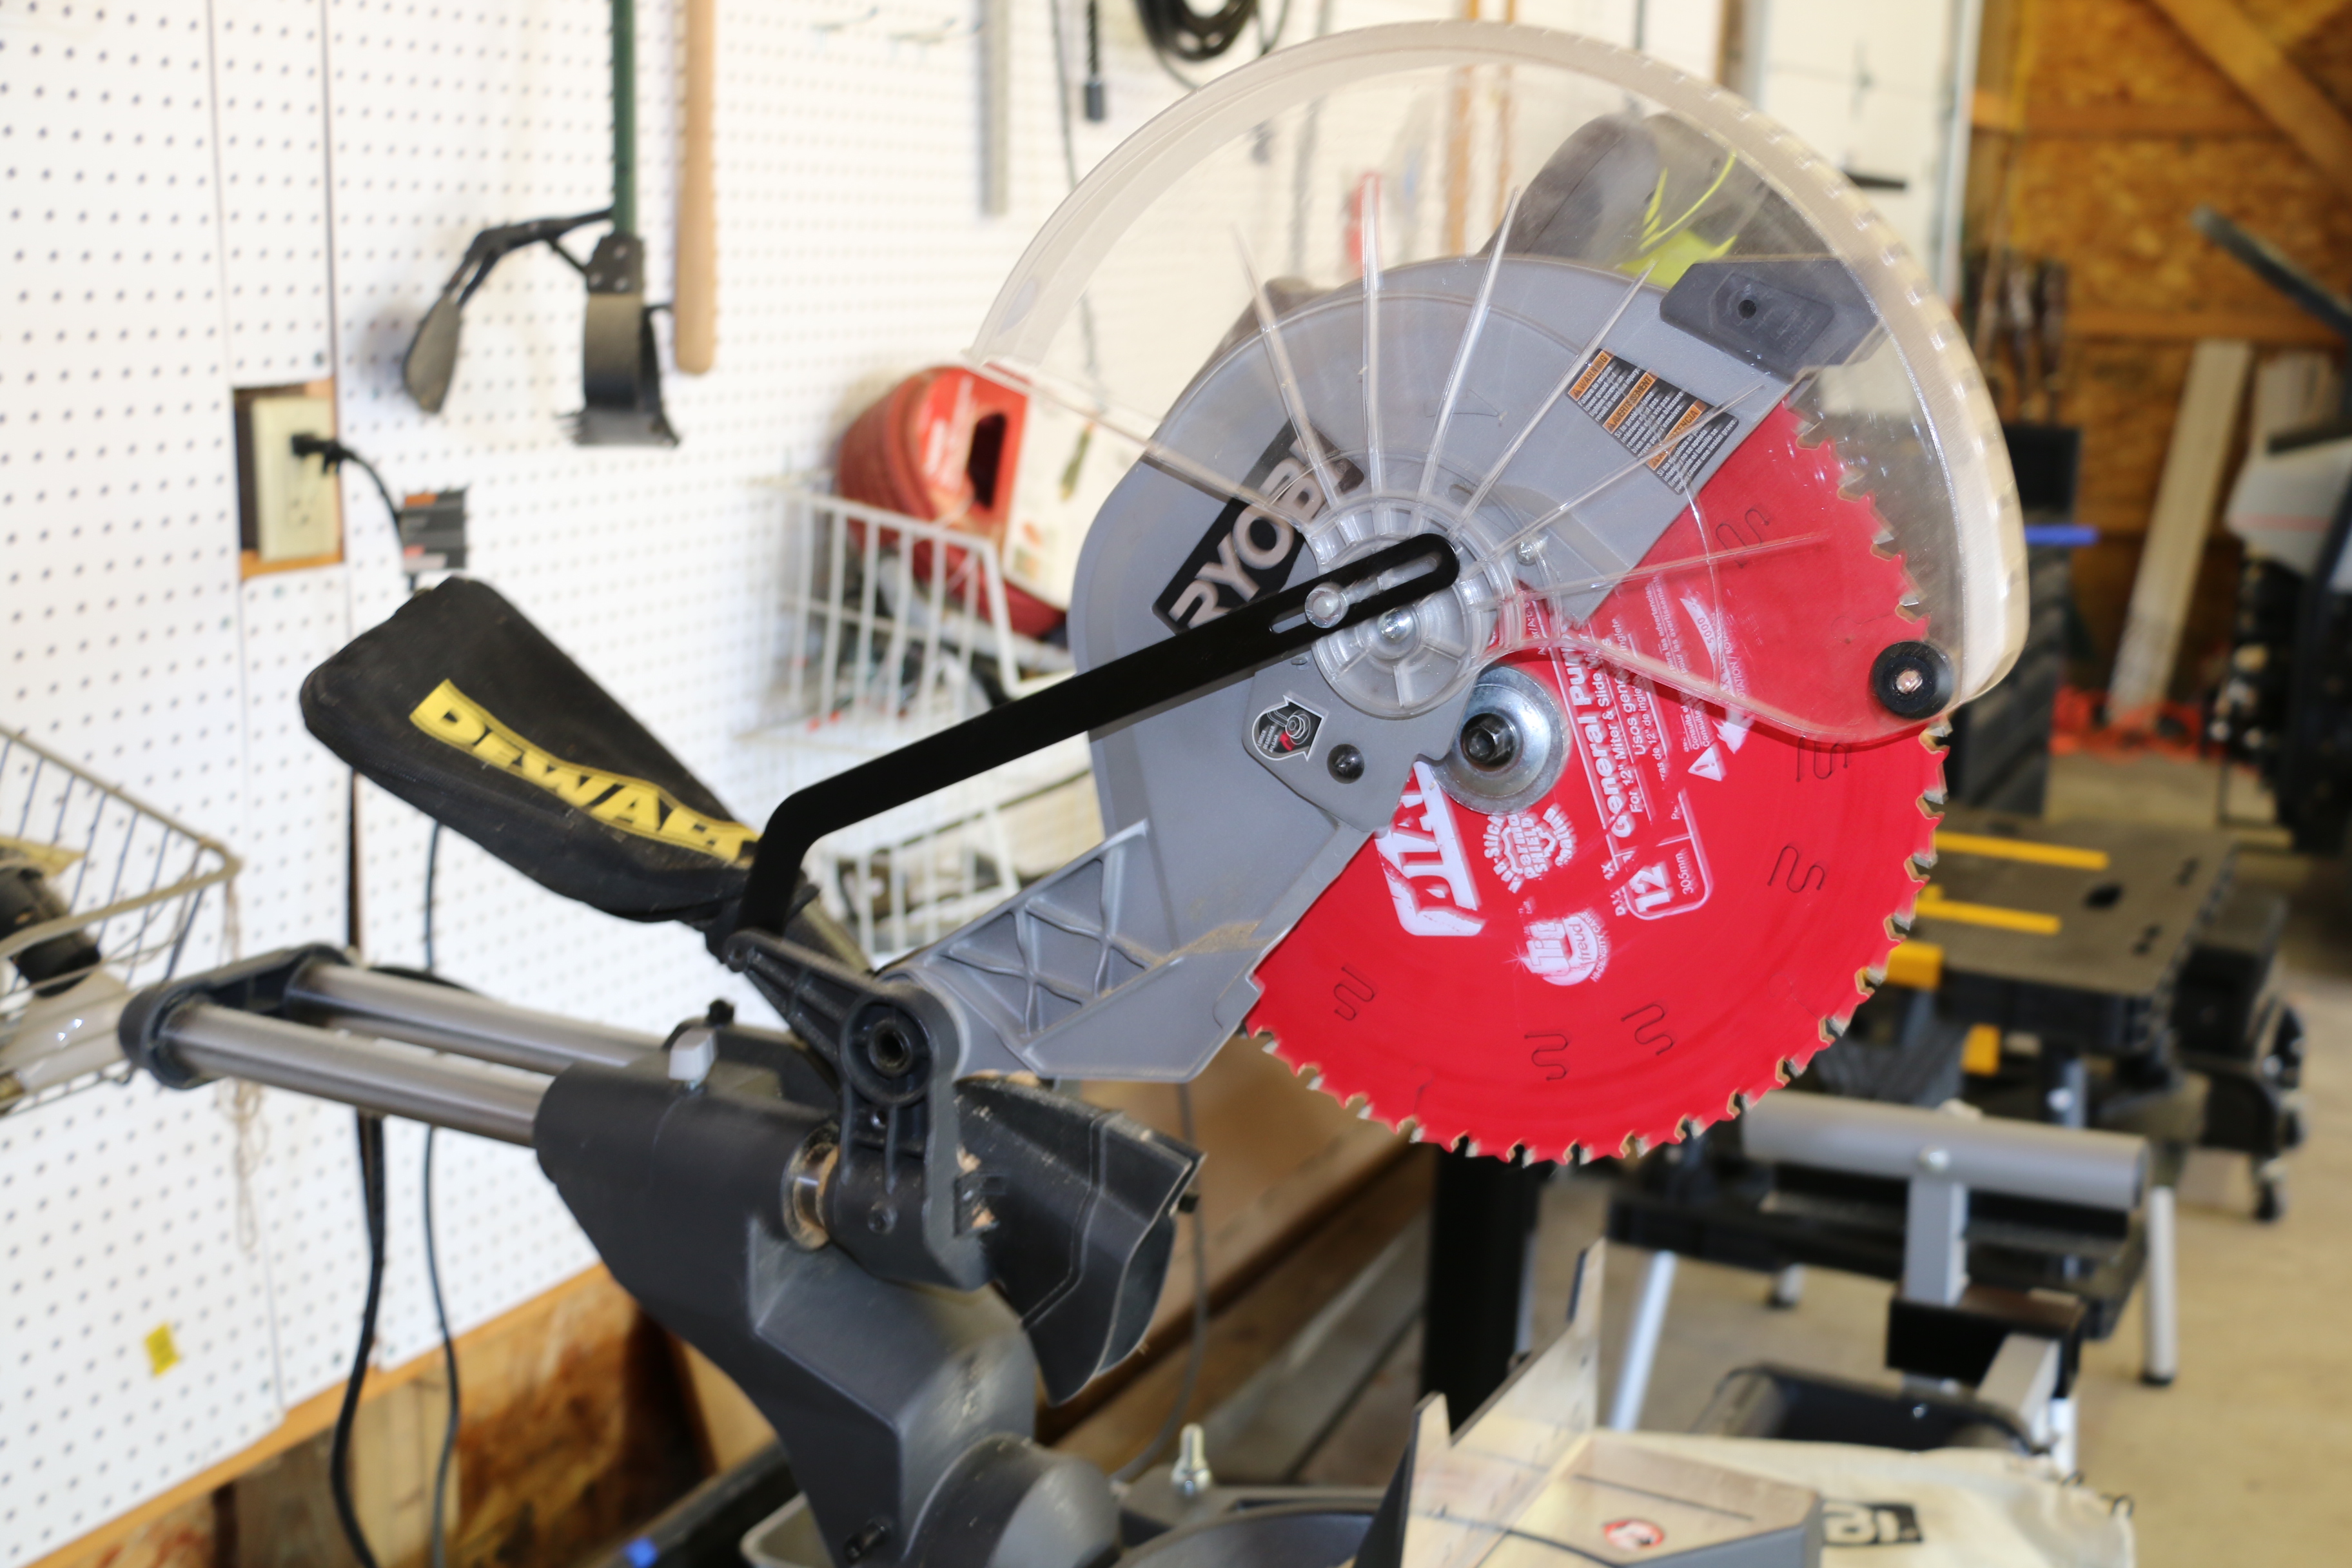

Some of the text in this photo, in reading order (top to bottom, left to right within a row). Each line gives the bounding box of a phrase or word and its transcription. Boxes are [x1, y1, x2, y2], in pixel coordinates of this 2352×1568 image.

[1577, 387, 1594, 406] Failure
[1583, 395, 1598, 411] lower
[1594, 382, 1609, 398] guard
[1588, 398, 1606, 417] tighten
[1648, 397, 1660, 409] pas
[1594, 406, 1609, 422] result
[1625, 425, 1645, 448] remonté
[1652, 405, 1661, 415] vis
[1659, 395, 1671, 407] pas
[1631, 439, 1643, 453] bien
[1661, 390, 1683, 415] blessure
[1613, 429, 1622, 438] Si
[1619, 424, 1627, 432] le
[1680, 453, 1688, 461] no
[1685, 446, 1693, 455] se
[1690, 428, 1709, 449] aprieta
[1694, 434, 1712, 454] tornillo
[1709, 427, 1718, 436] se
[1662, 462, 1670, 471] no
[1686, 459, 1702, 477] causar
[1707, 432, 1723, 451] lesión
[1697, 616, 1714, 643] 5000
[1660, 638, 1668, 650] las
[1671, 639, 1680, 651] les
[1663, 652, 1675, 670] para
[1675, 654, 1687, 672] pour
[1591, 672, 1607, 706] Slide
[1601, 710, 1614, 721] &
[1642, 713, 1651, 725] de
[1607, 724, 1626, 758] Miter
[1627, 717, 1646, 753] Usos
[1685, 714, 1699, 749] Consulte
[1652, 747, 1661, 760] de
[409, 680, 759, 862] DEWALT
[1576, 715, 1631, 838] General
[1628, 791, 1642, 811] For
[1675, 852, 1693, 894] 305mm
[1569, 923, 1591, 960] freud
